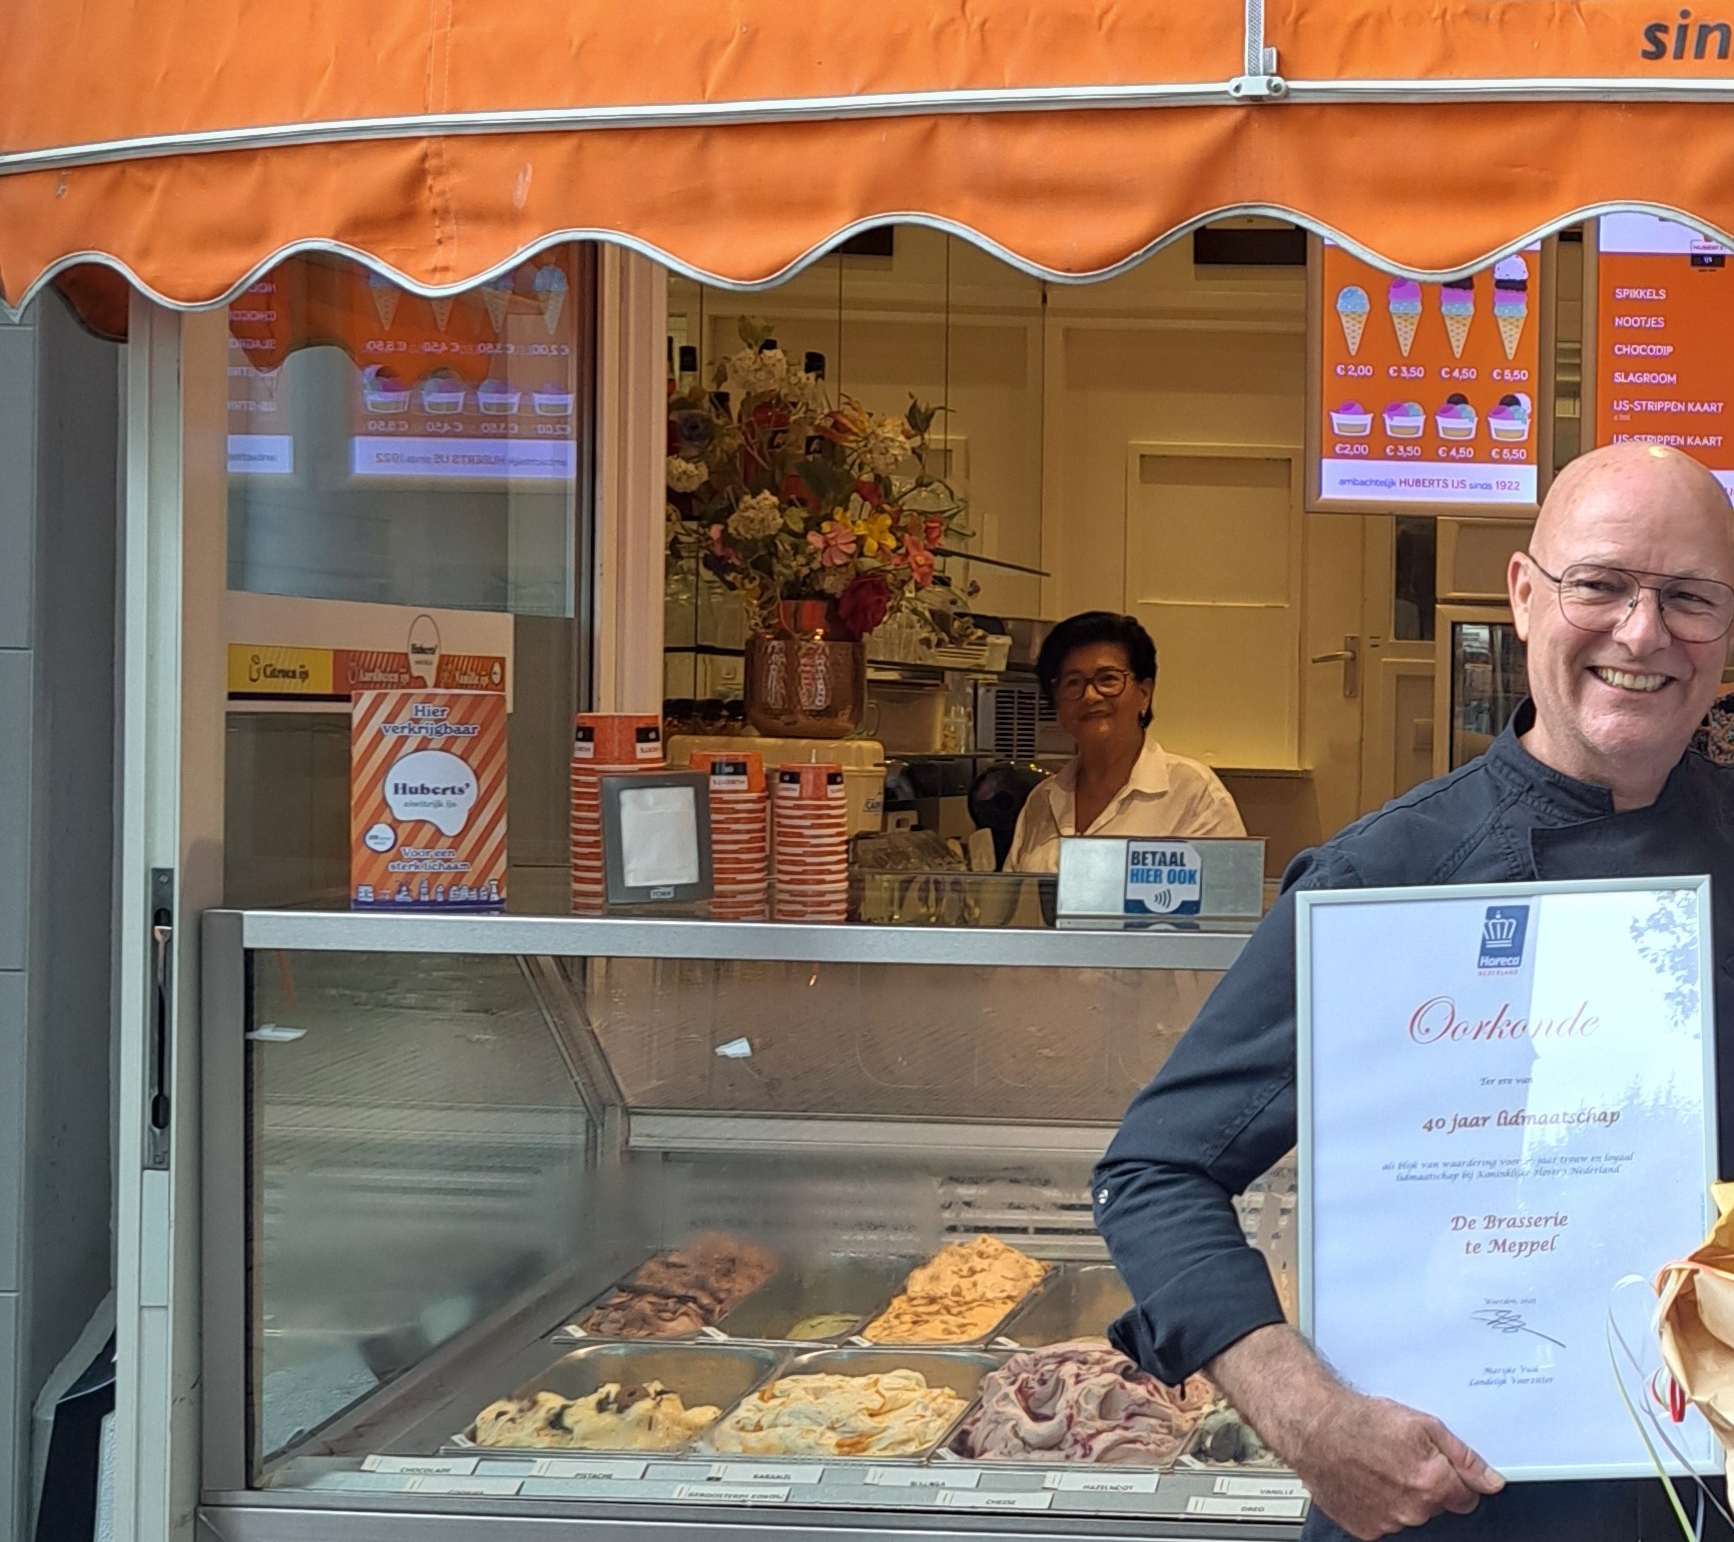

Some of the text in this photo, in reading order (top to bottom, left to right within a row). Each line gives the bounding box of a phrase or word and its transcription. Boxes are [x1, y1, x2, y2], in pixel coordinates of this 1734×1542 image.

[1615, 288, 1667, 300] SPIKKELS
[1614, 316, 1665, 328] NOOTJES
[1614, 344, 1674, 356] CHOCODIP
[1348, 365, 1373, 378] 2,00
[1613, 372, 1677, 384] SLAGROOM
[1613, 400, 1724, 413] IJS-STRIPPEN KAART
[1687, 436, 1723, 447] KAART
[1399, 478, 1449, 488] HUBERTS
[1451, 479, 1467, 490] IJS
[1495, 480, 1520, 490] 1922
[413, 705, 448, 718] Hier
[382, 723, 479, 737] verkrijgbaar
[393, 782, 470, 796] Huberts'
[402, 848, 456, 858] Voor een
[1130, 851, 1186, 867] BETAAL
[390, 861, 470, 871] sterk lichaam
[1129, 868, 1197, 885] HIER OOK
[650, 887, 674, 898] TORK
[1479, 954, 1521, 967] Horeca
[1477, 968, 1520, 977] NEDERLAND
[1409, 995, 1600, 1045] Oorkonde
[1479, 1076, 1533, 1086] Ter ere van
[1422, 1107, 1621, 1135] 40 jaar lidmaatschap
[1382, 1162, 1395, 1171] als
[1397, 1160, 1418, 1172] blijk
[1420, 1161, 1439, 1169] van
[1442, 1158, 1497, 1171] waardering
[1499, 1158, 1520, 1166] voor
[1604, 1152, 1635, 1163] loyaal
[1395, 1163, 1620, 1183] lidmaatschap bij Koninklijke Nederland
[1450, 1211, 1569, 1232] De Brasserie
[1464, 1234, 1560, 1259] te Meppel
[573, 1472, 614, 1480] PISTACHE
[1082, 1484, 1134, 1492] HAZELNOOT
[1259, 1488, 1296, 1496] VANILLE
[1240, 1504, 1266, 1513] OREO
